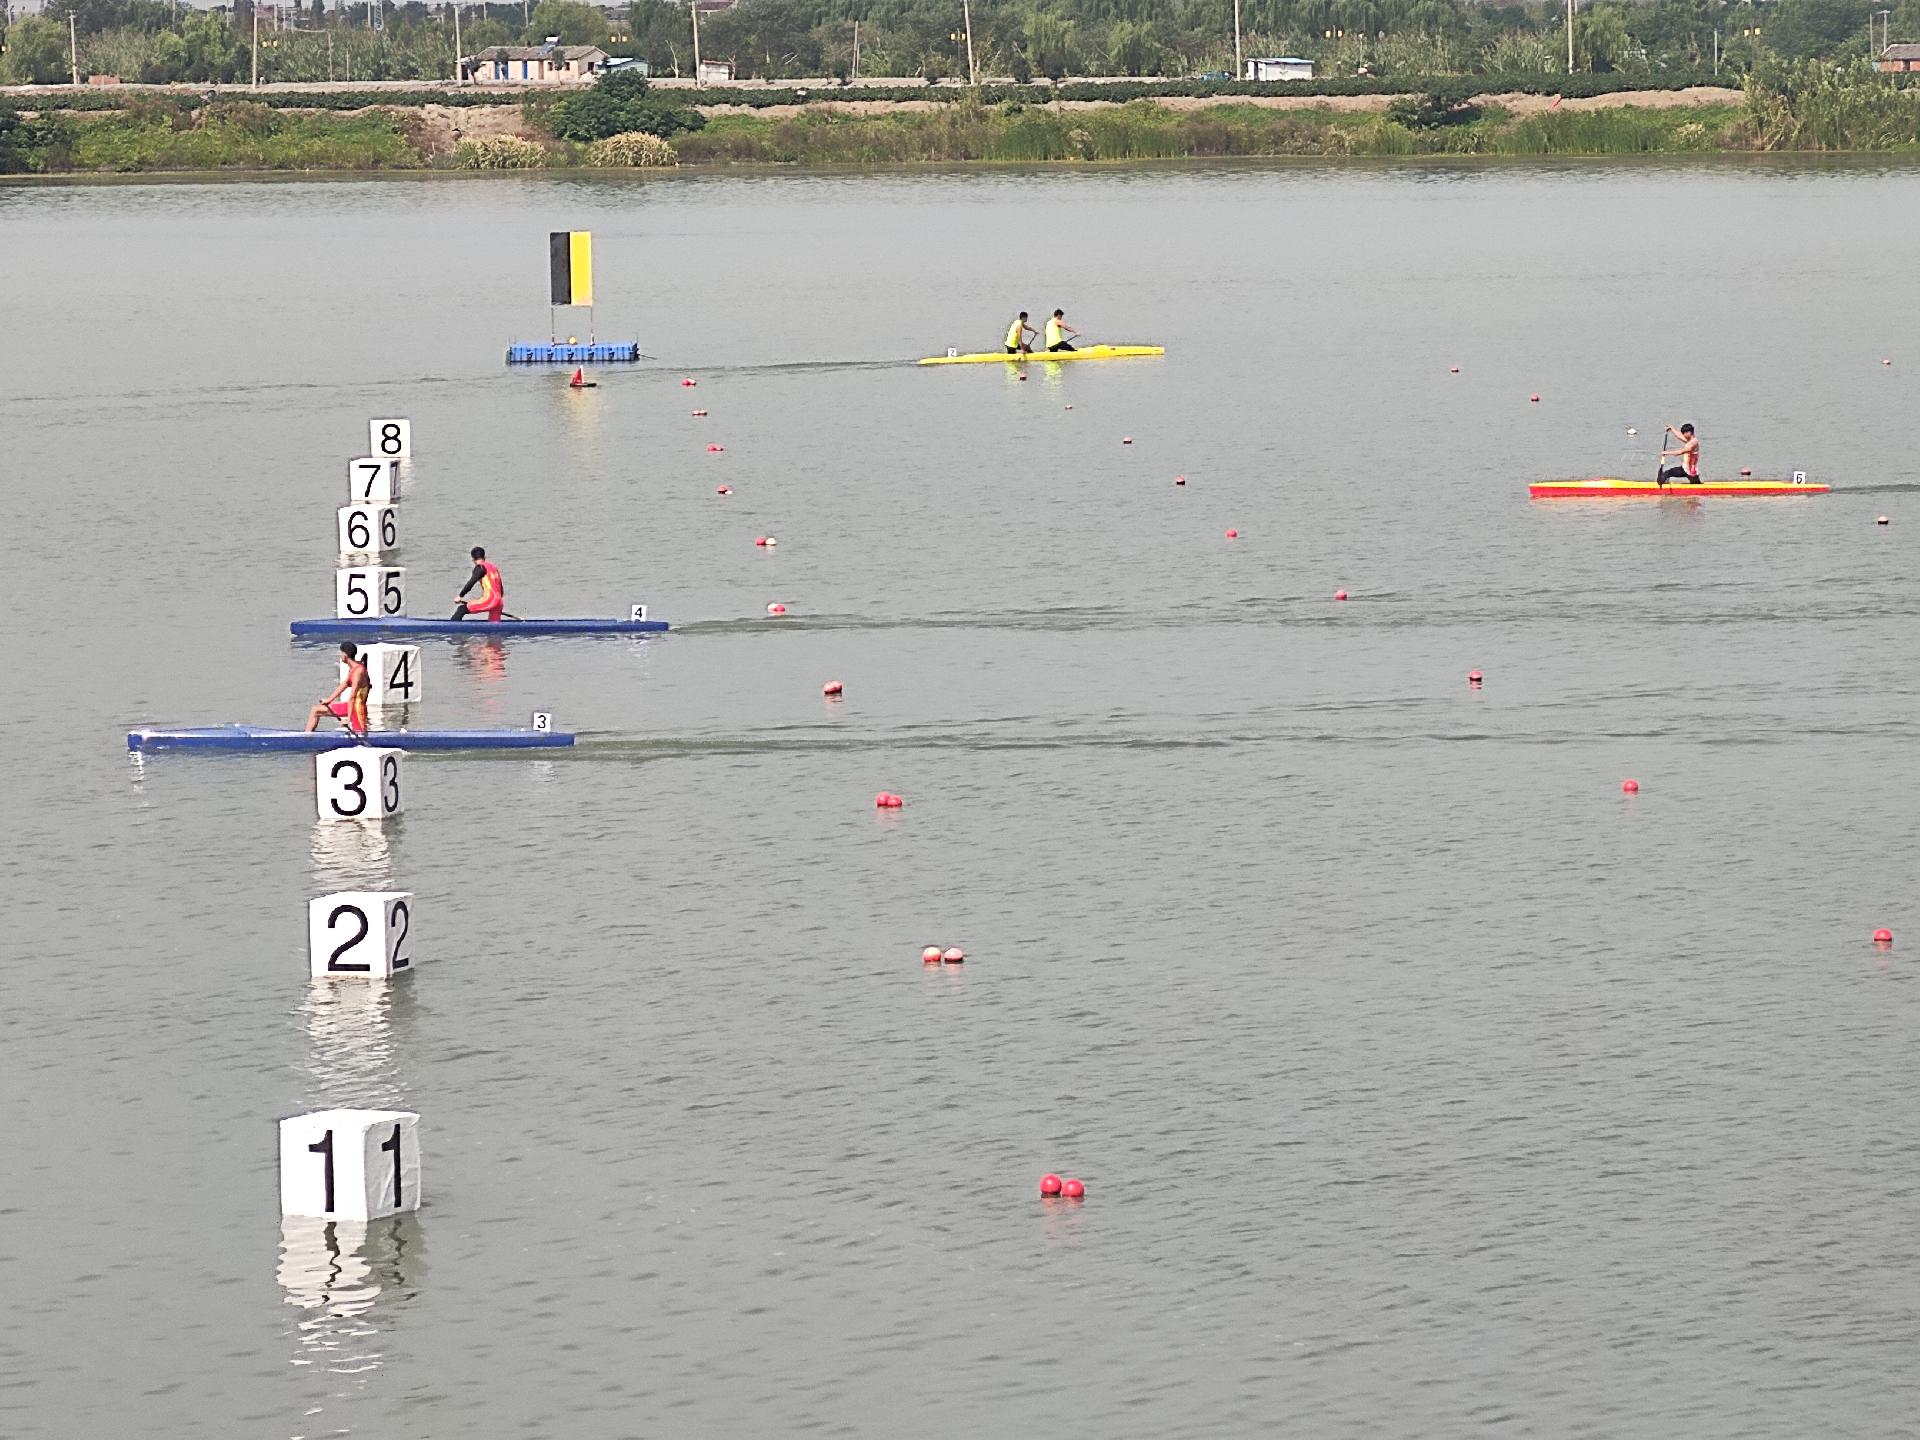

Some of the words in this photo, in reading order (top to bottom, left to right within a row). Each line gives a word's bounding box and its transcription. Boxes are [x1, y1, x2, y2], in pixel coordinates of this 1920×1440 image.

[381, 424, 401, 454] 8
[359, 465, 381, 497] 7
[1796, 474, 1803, 484] 6
[348, 511, 370, 548] 6
[382, 509, 396, 547] 6
[347, 574, 369, 614] 5
[384, 572, 402, 614] 5
[634, 606, 642, 618] 4
[390, 651, 414, 699] 4
[537, 714, 547, 728] 3
[331, 760, 367, 816] 3
[384, 756, 399, 812] 3
[328, 905, 370, 972] 2
[391, 901, 409, 969] 2
[308, 1129, 334, 1212] 1
[381, 1124, 401, 1208] 1
